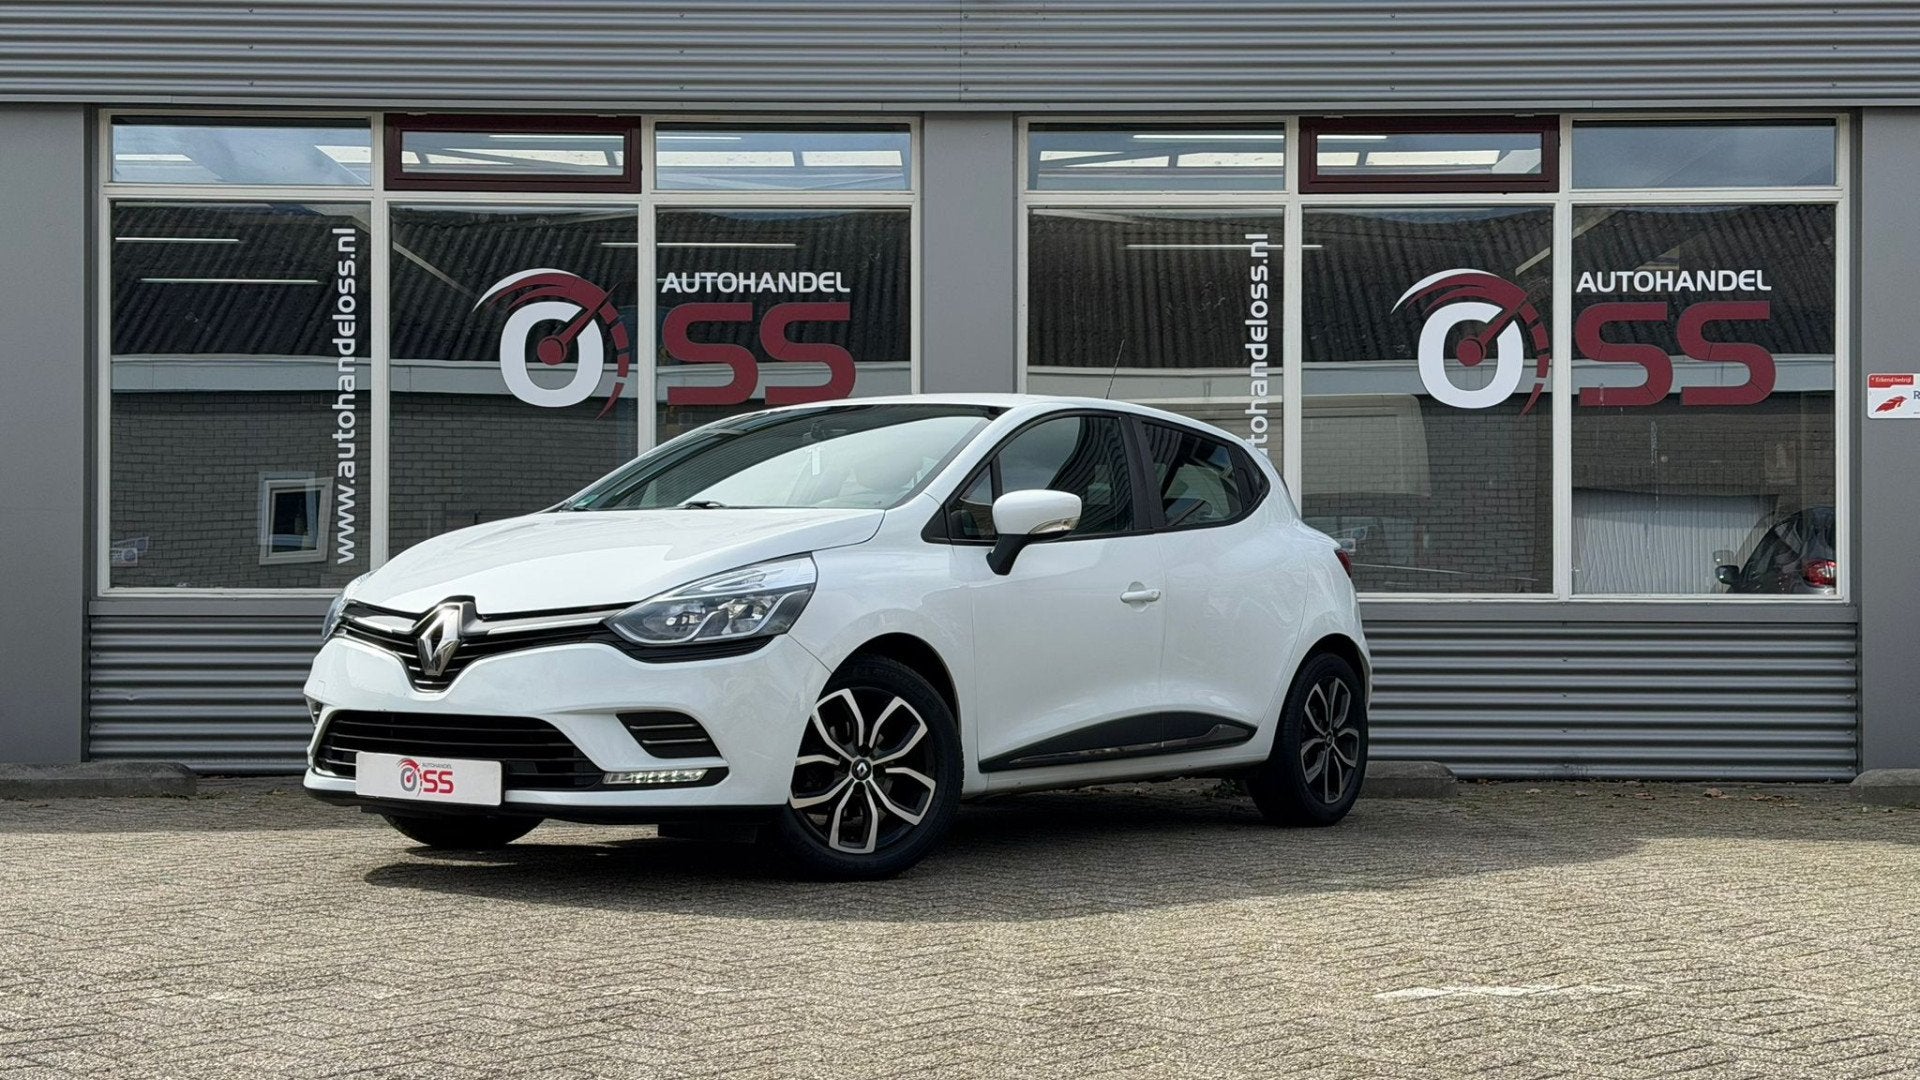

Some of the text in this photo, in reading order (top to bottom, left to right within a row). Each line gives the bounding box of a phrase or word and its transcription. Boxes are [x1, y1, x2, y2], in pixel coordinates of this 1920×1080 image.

[661, 272, 851, 293] AUTOHANDEL
[1576, 270, 1772, 293] AUTOHANDEL
[500, 301, 856, 407] OSS
[1418, 301, 1776, 408] OSS
[332, 228, 356, 565] www.autohandeloss.nl
[400, 767, 455, 794] OSS
